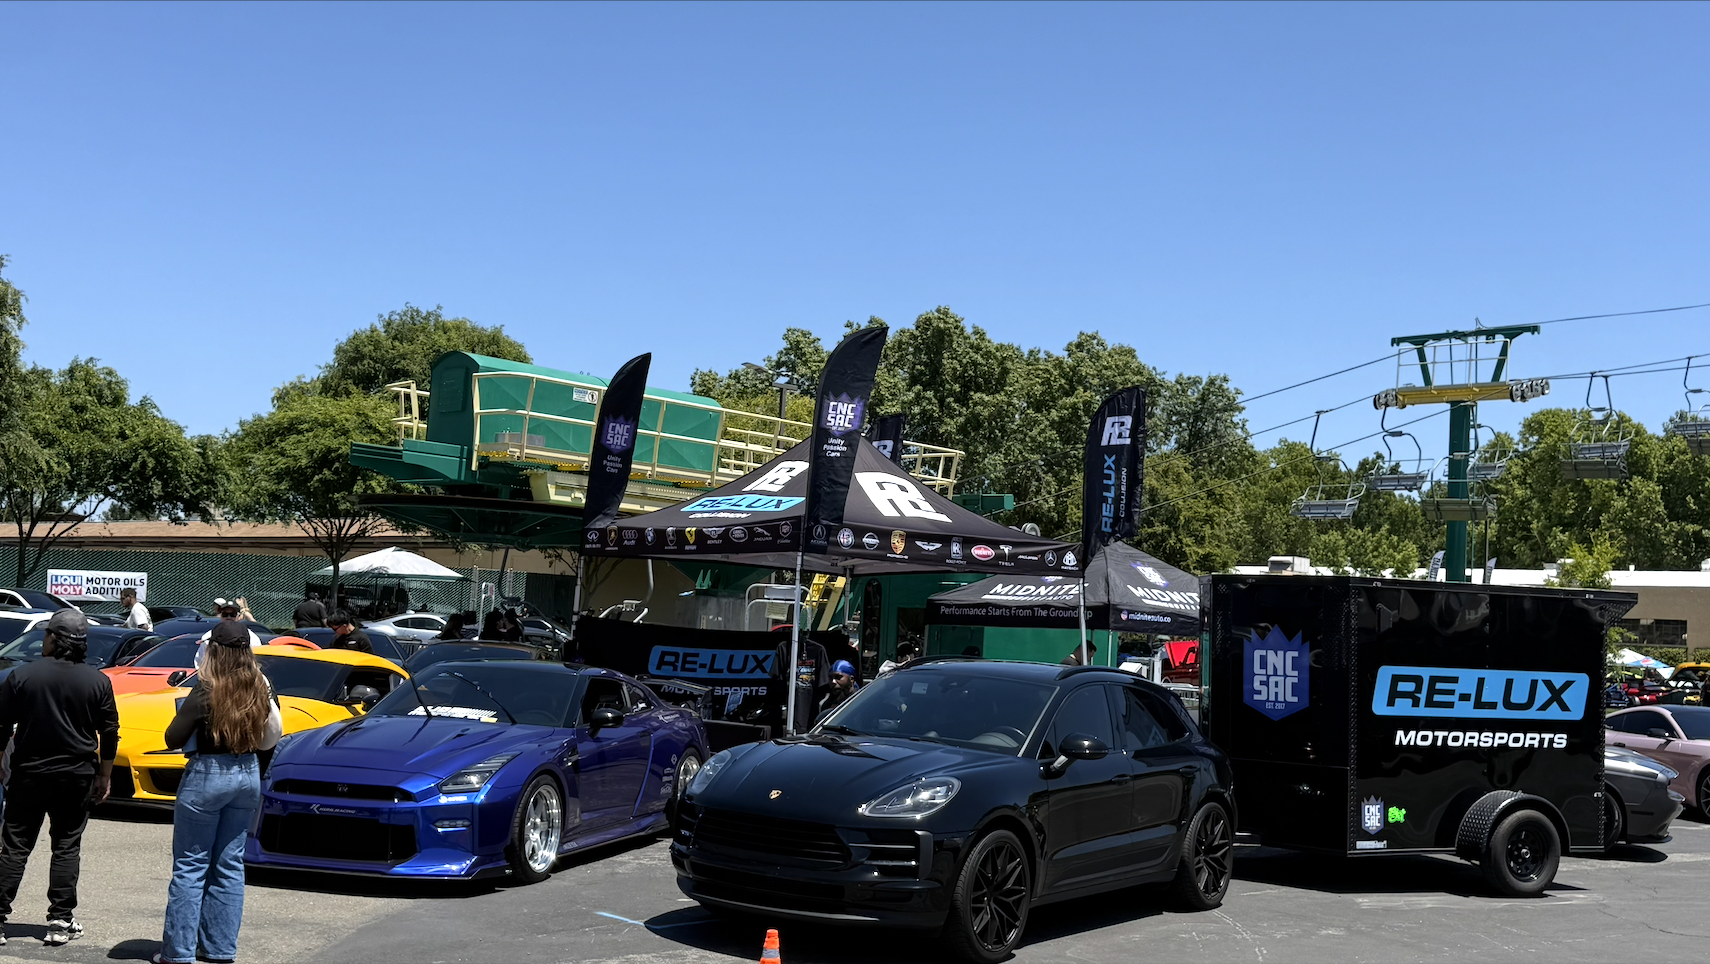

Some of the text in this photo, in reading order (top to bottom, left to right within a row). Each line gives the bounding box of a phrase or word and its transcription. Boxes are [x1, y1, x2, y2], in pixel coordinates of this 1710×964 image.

[828, 402, 856, 415] CNC
[826, 414, 854, 427] SAC
[608, 422, 631, 436] CNC
[606, 433, 629, 446] SAC
[827, 438, 845, 446] Unity
[823, 444, 848, 452] Passion
[606, 454, 622, 462] Unity
[605, 466, 619, 474] Cars
[1101, 453, 1116, 533] RE-LUX
[1119, 467, 1128, 518] COLLISION
[691, 496, 796, 510] RE-LUX
[52, 575, 145, 587] LIQUI MOTOR OILS
[51, 585, 81, 596] MOLY
[989, 583, 1090, 596] MIDNITE
[1126, 584, 1200, 604] MIDNIT
[940, 605, 987, 616] Performance
[988, 607, 1010, 616] Starts
[1011, 607, 1032, 616] From
[1034, 607, 1048, 617] The
[1049, 608, 1079, 618] Ground
[1128, 612, 1172, 623] midniteauto.co
[655, 650, 771, 674] RE-LUX
[1253, 649, 1299, 676] CNC
[1253, 675, 1299, 703] SAC
[1386, 673, 1577, 713] RE-LUX
[1395, 730, 1568, 749] MOTORSPORTS
[1365, 804, 1381, 816] CNC
[1365, 815, 1381, 827] SAC
